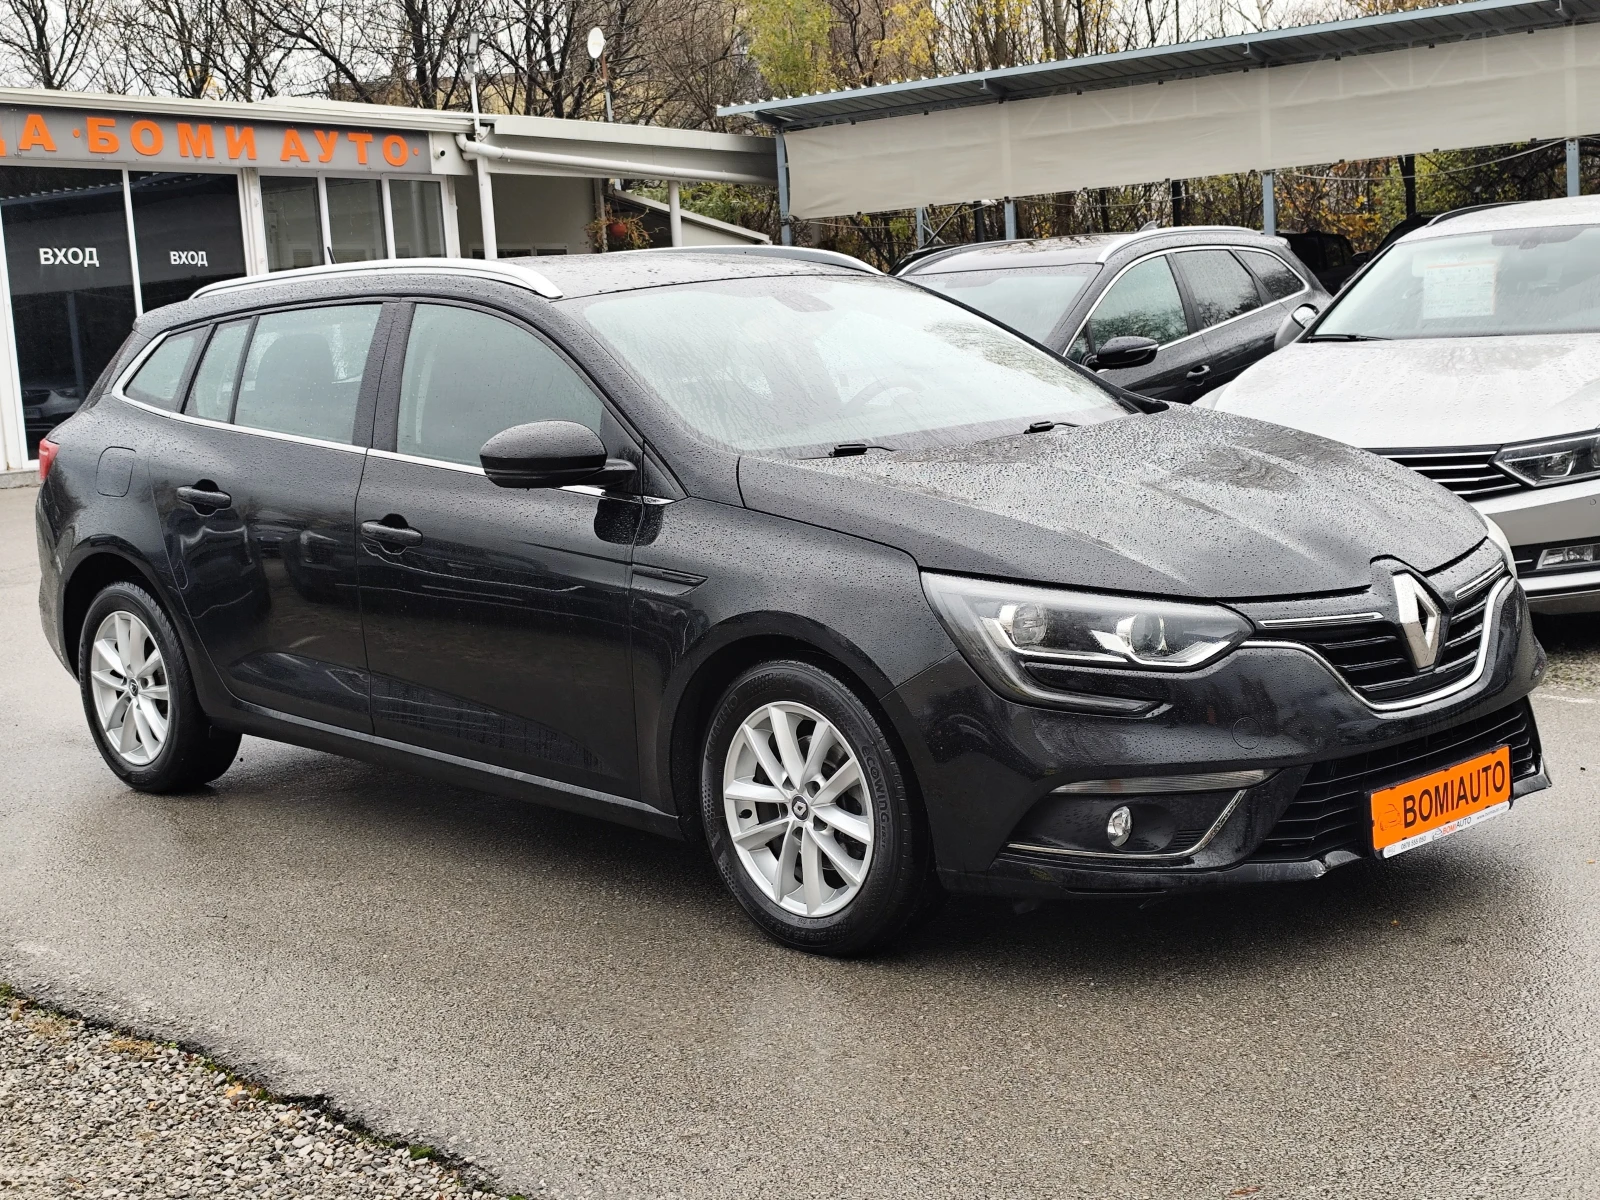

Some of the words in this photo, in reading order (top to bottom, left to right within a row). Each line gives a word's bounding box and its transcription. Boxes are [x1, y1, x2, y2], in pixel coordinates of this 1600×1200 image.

[0, 113, 57, 158] А
[86, 116, 258, 161] БОМИ
[280, 129, 409, 167] АУТО
[39, 247, 100, 268] ВХОД
[170, 250, 208, 268] ВХОД
[1403, 760, 1506, 829] BOMIAUTO
[1442, 817, 1472, 835] BOMIAUTO
